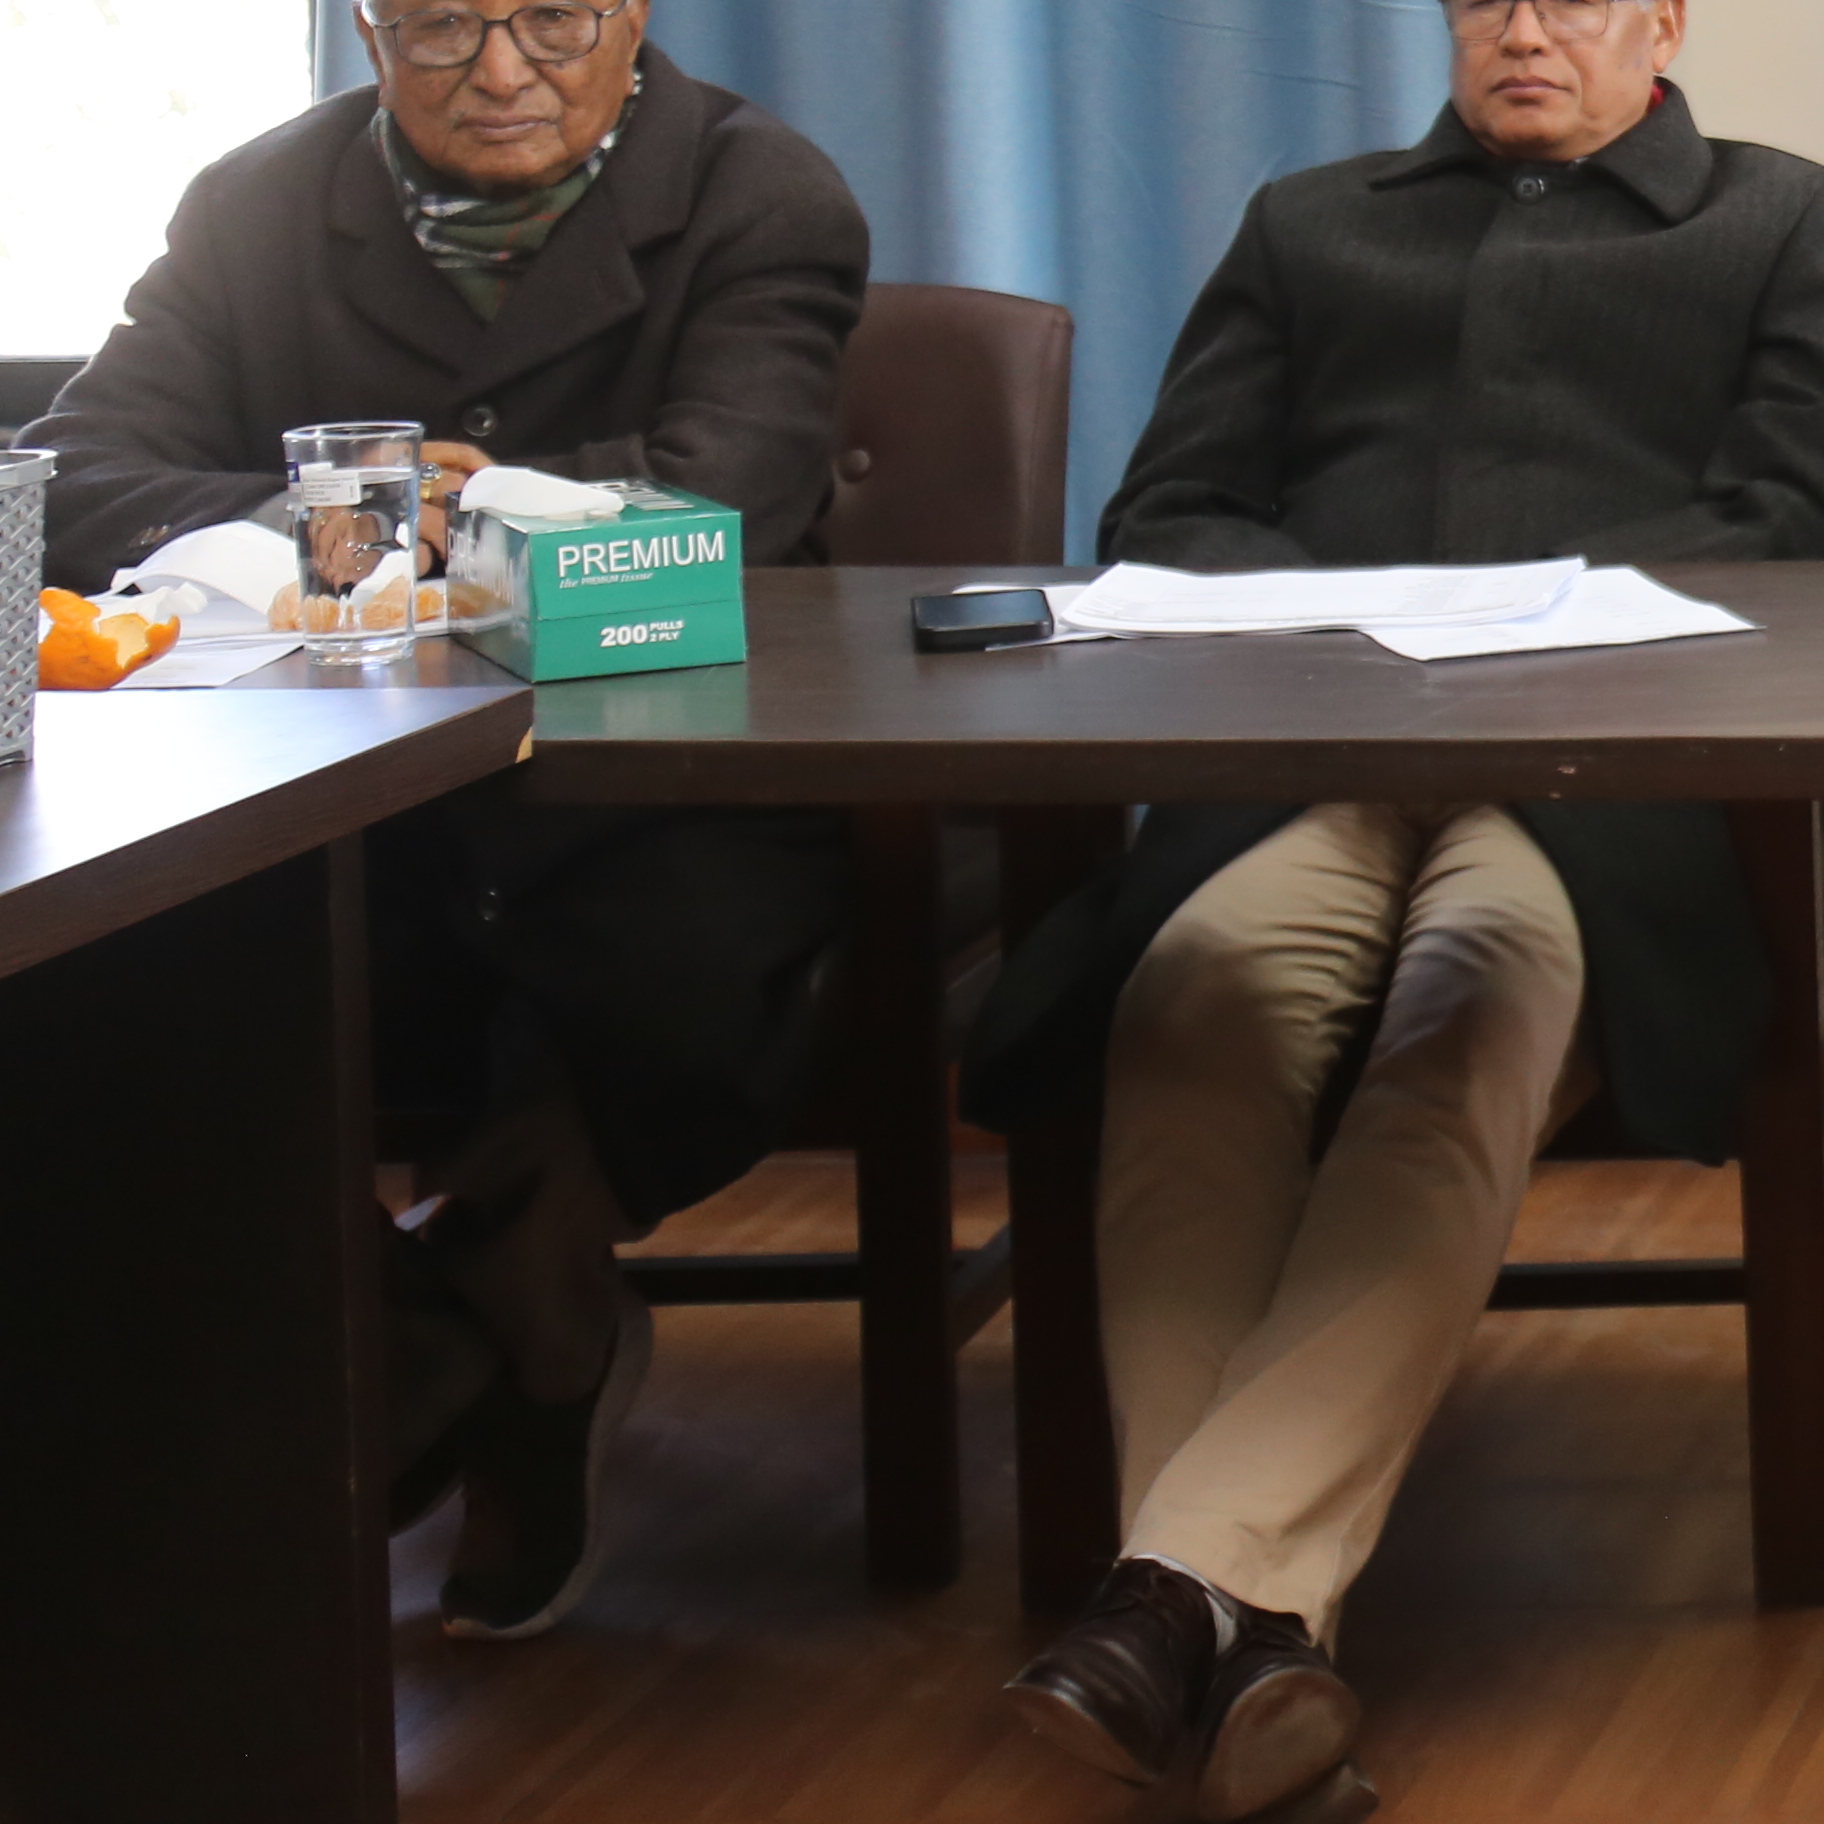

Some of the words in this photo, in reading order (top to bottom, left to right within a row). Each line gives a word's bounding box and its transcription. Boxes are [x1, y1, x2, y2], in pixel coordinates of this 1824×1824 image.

[557, 529, 726, 578] PREMIUM
[649, 619, 686, 632] PULLS
[600, 623, 648, 648] 200
[659, 630, 681, 642] PLY
